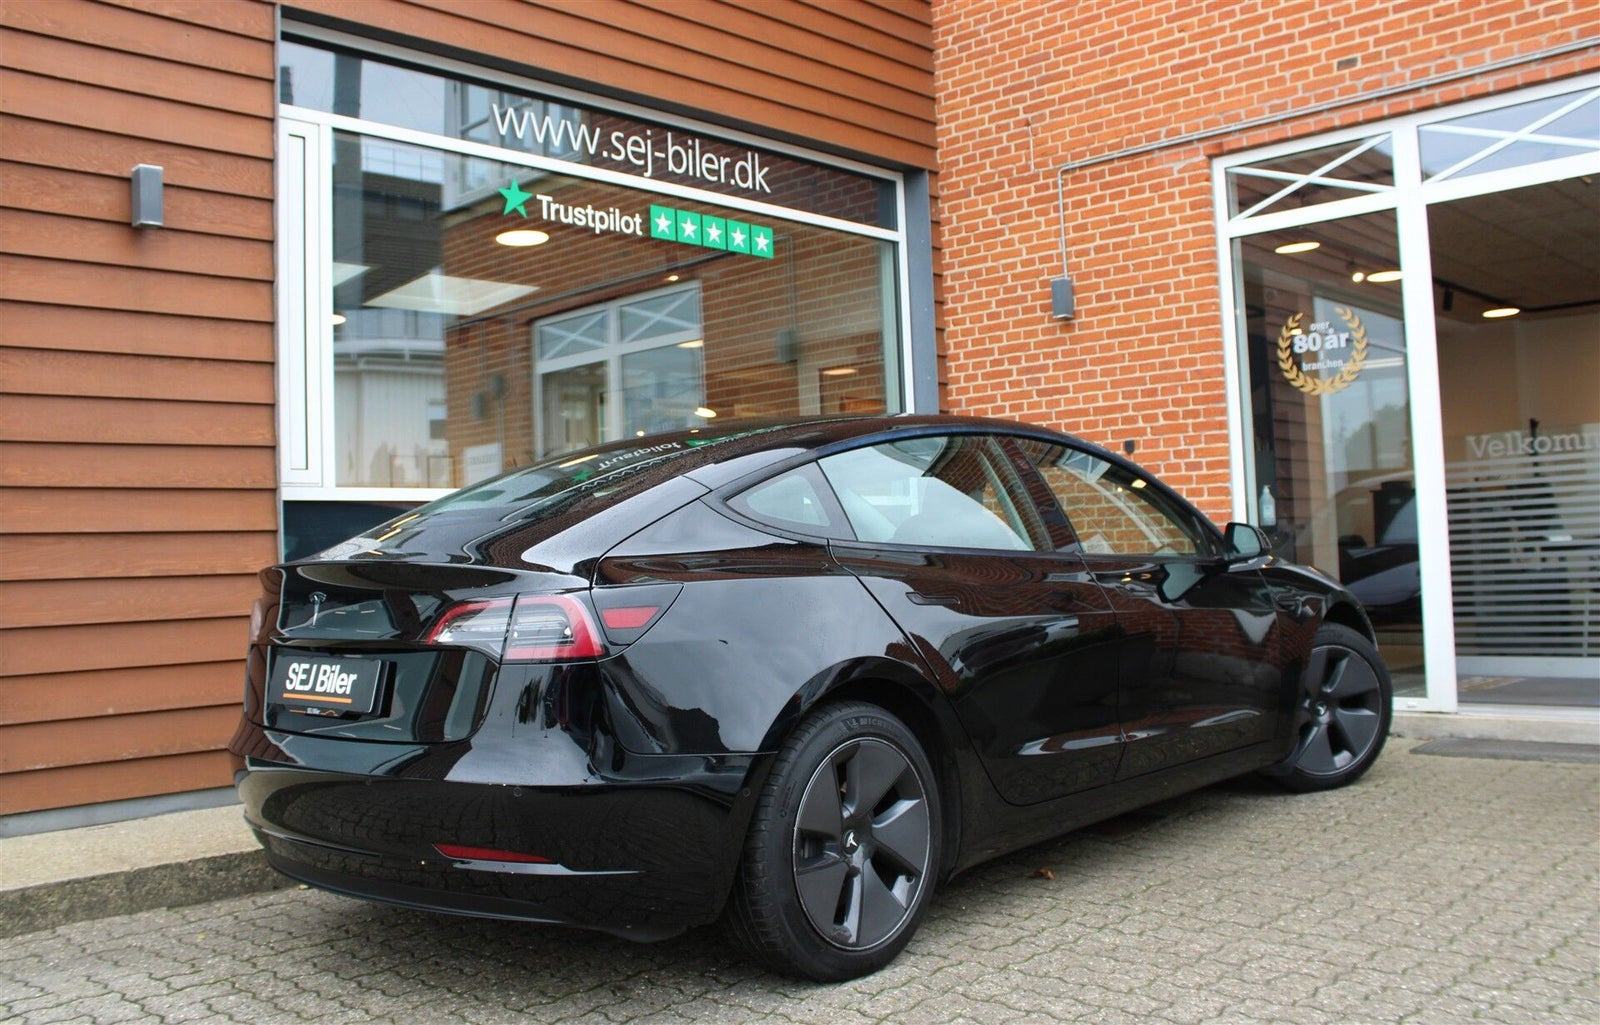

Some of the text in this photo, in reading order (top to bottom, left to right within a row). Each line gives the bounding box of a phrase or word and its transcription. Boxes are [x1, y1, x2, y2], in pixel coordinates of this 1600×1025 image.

[492, 103, 772, 193] www.sej-biler.dk
[536, 194, 643, 236] Trustpilot
[1293, 327, 1350, 353] 80 år
[1311, 322, 1331, 332] over
[1302, 359, 1344, 371] branchen
[285, 662, 358, 695] SEJ Biler
